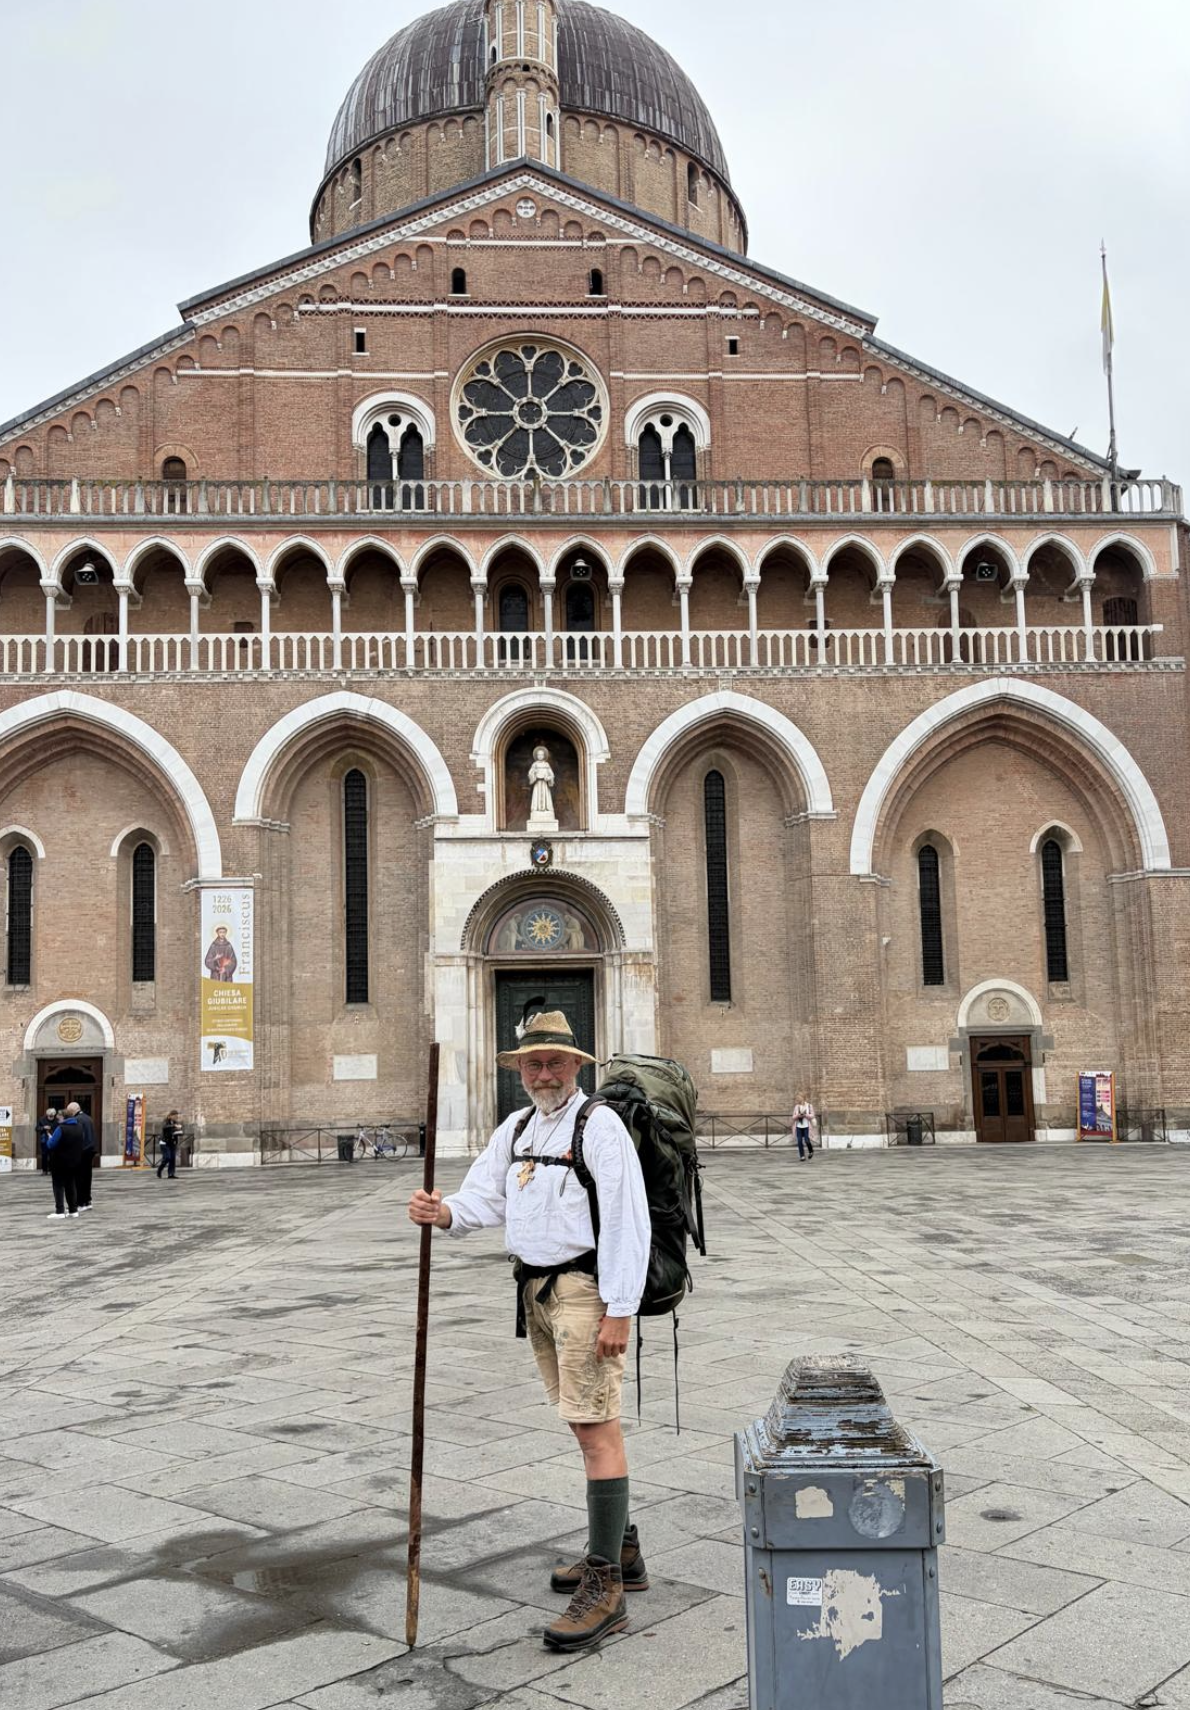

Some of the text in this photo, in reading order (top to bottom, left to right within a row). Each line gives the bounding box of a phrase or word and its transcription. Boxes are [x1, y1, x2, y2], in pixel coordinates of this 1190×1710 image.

[213, 895, 232, 904] 1226
[212, 905, 232, 914] 2026
[239, 893, 250, 975] Franciscus
[213, 989, 241, 997] CHIESA
[207, 997, 247, 1005] GIUBILARE
[789, 1579, 822, 1591] EASY
